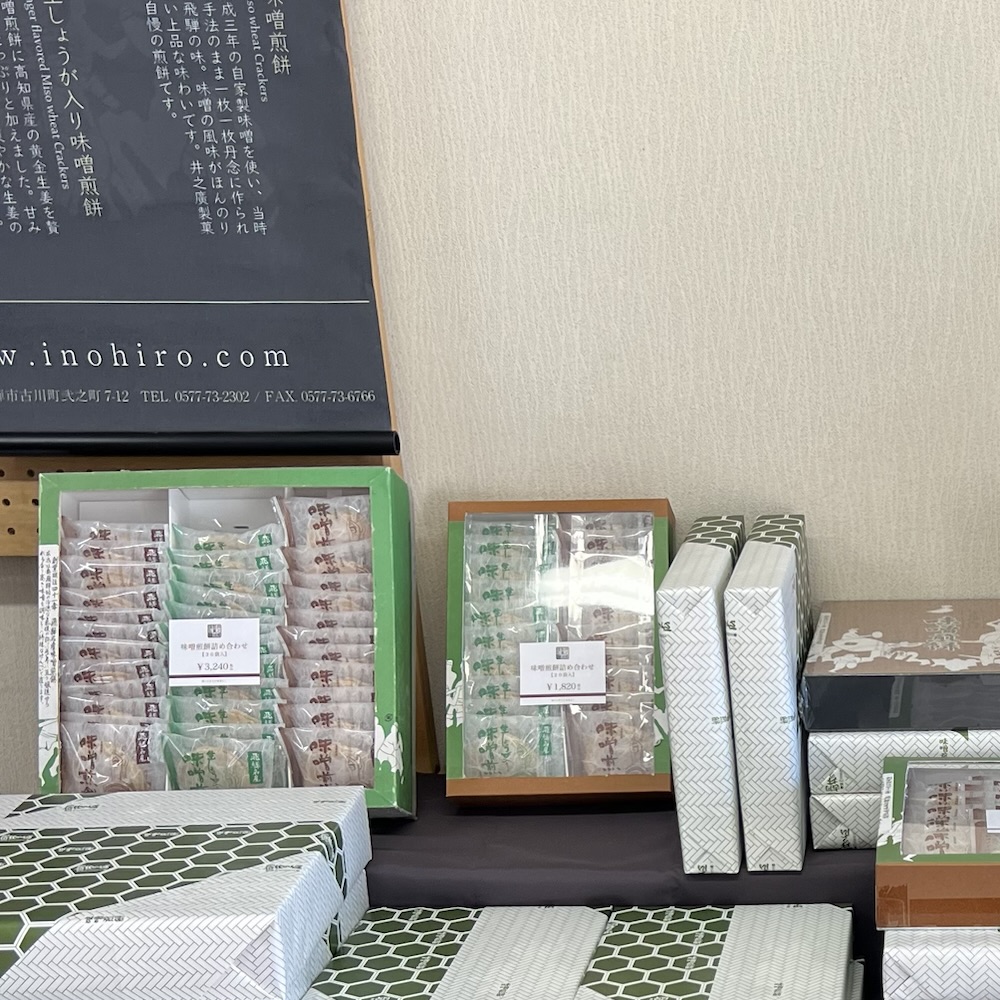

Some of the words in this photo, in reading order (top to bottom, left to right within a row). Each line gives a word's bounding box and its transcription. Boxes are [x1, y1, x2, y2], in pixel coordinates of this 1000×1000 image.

[249, 16, 261, 51] wheat
[254, 53, 269, 103] Crackers
[31, 25, 50, 71] flavored
[41, 74, 53, 102] Miso
[47, 105, 60, 139] wheat
[54, 142, 69, 190] Crackers
[104, 389, 130, 402] 7-12
[175, 390, 250, 403] 0577-73-2302
[301, 390, 376, 403] 0577-73-6766
[180, 642, 248, 650] 味噌煎餅詰め合わせ
